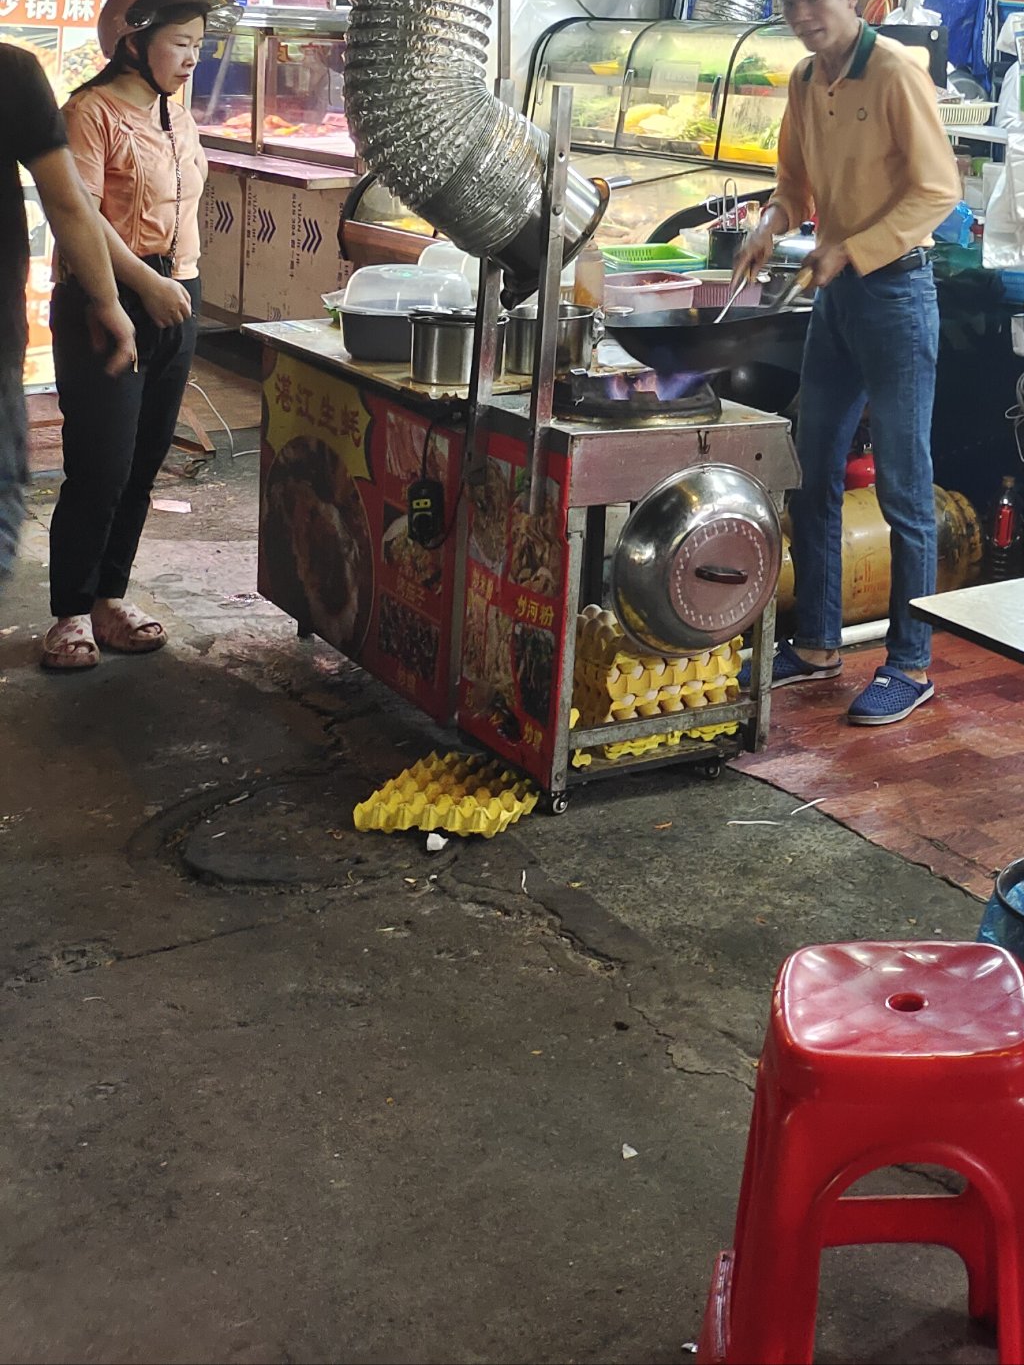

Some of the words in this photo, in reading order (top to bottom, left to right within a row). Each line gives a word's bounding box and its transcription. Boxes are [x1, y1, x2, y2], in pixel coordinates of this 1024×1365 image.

[275, 373, 361, 448] 湛江生蚝
[514, 593, 554, 627] 炒河粉
